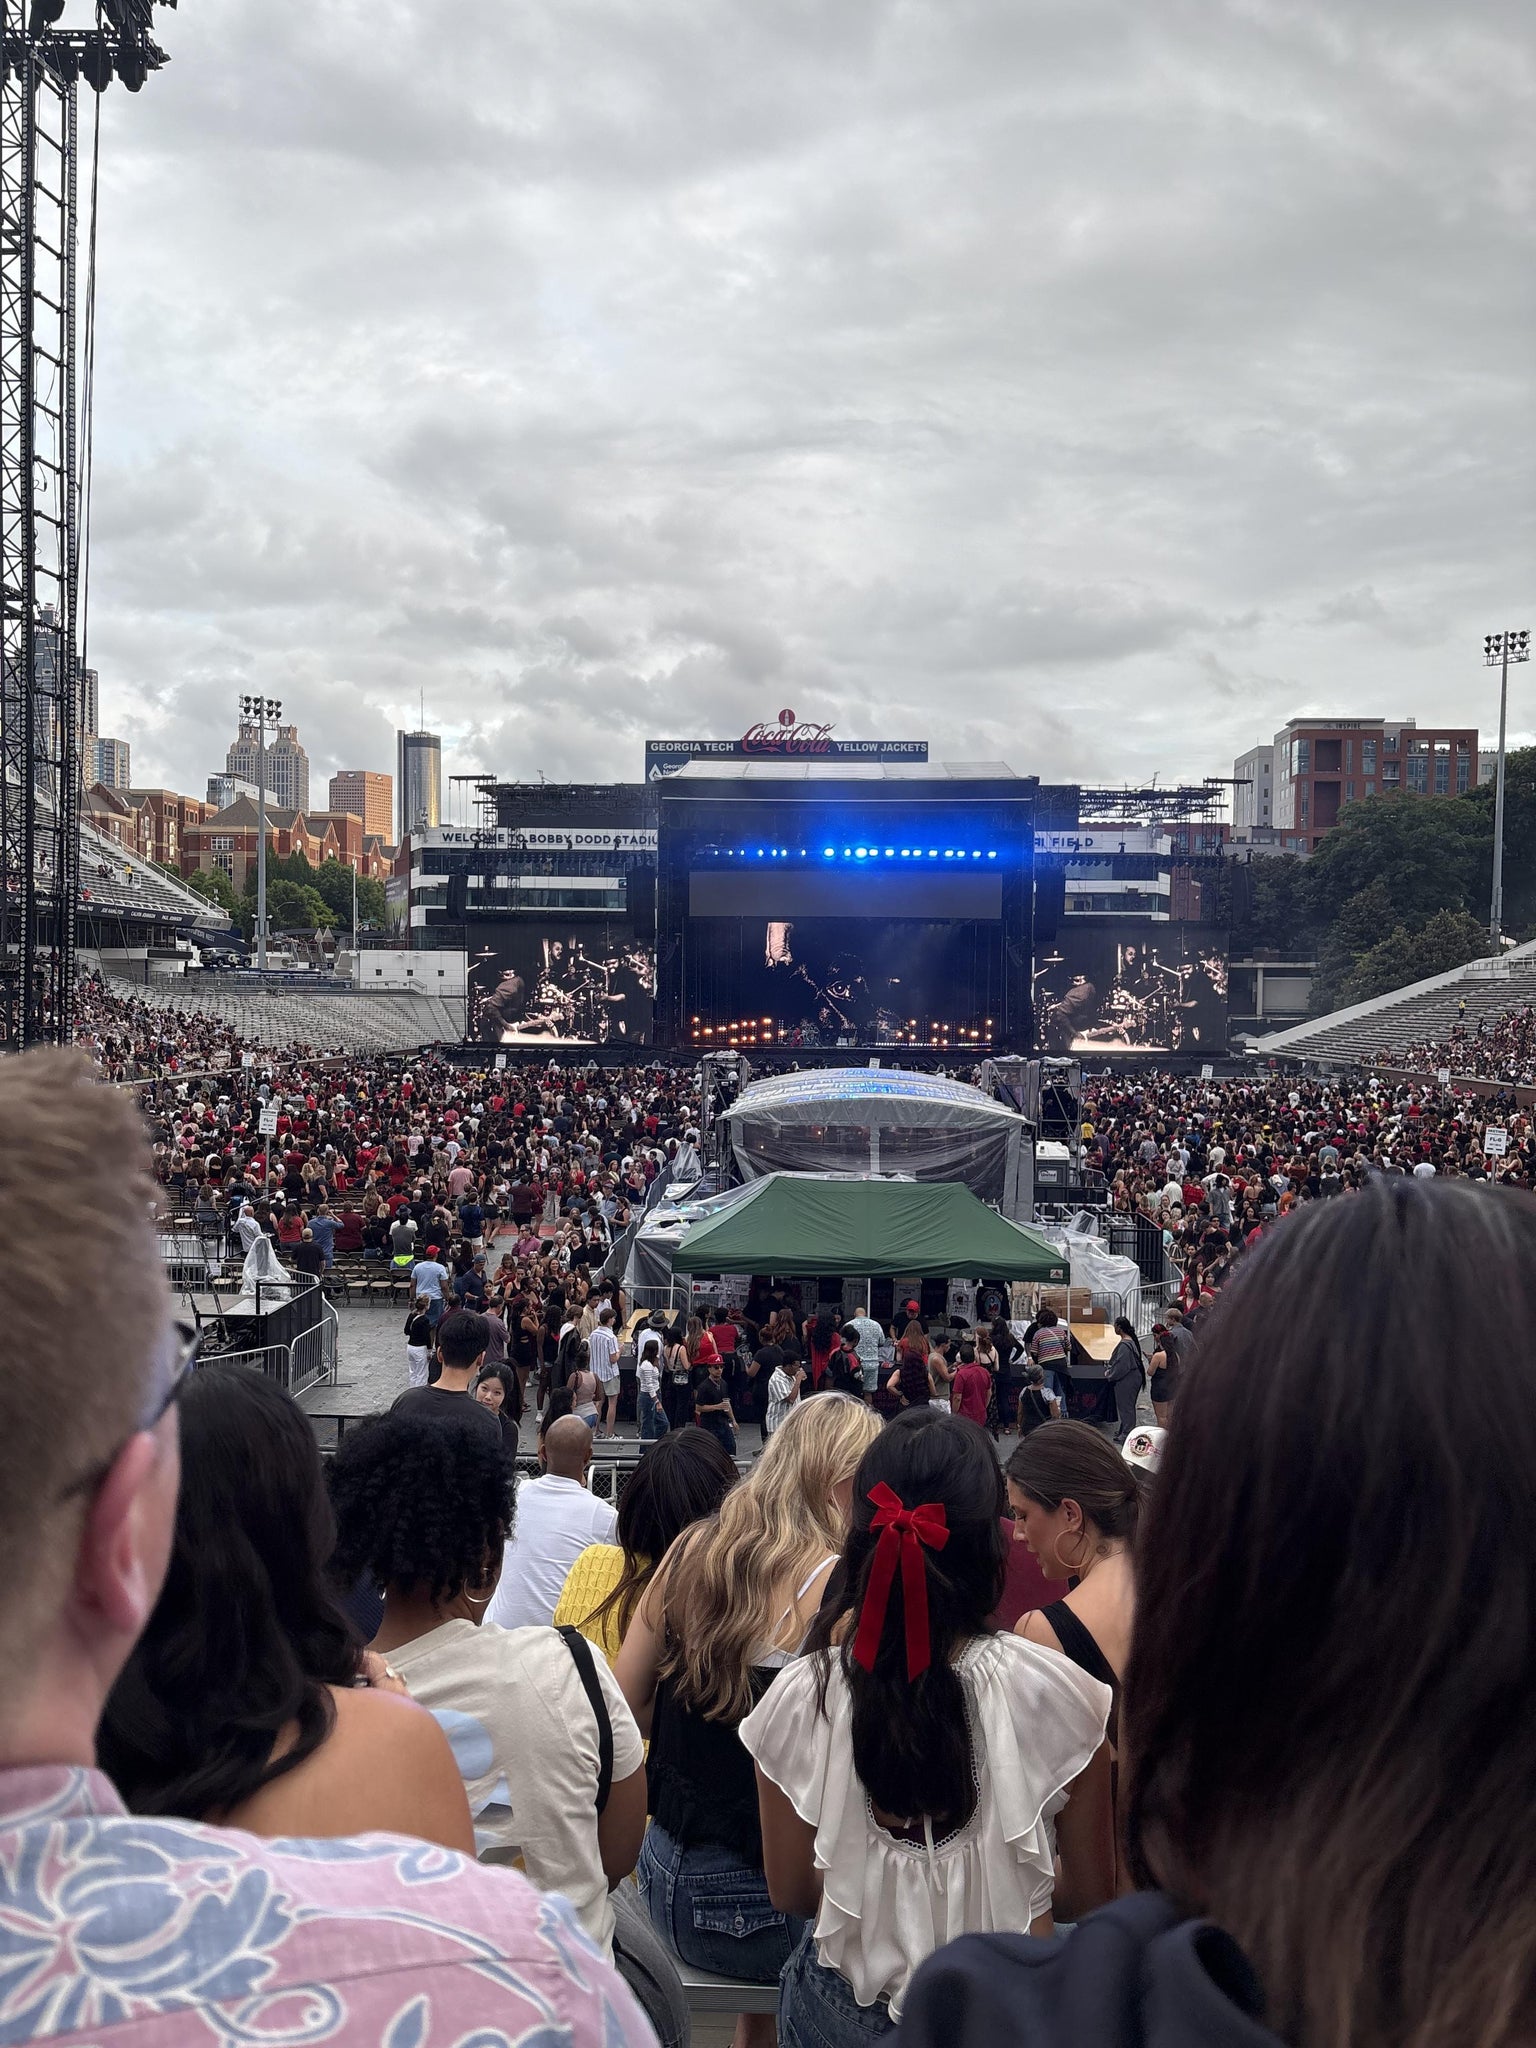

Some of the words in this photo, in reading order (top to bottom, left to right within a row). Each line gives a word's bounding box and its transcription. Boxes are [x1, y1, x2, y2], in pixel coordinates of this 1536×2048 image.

[650, 742, 702, 752] GEORGIA
[703, 742, 734, 752] TECH
[836, 742, 878, 752] YELLOW
[880, 742, 928, 752] JACKETS
[662, 763, 685, 771] Georgi
[223, 781, 233, 789] W
[442, 832, 505, 843] WELCOME
[529, 834, 572, 844] BOBBY
[575, 834, 611, 844] DODD
[615, 835, 658, 846] STADIU
[1052, 837, 1094, 847] FIELD
